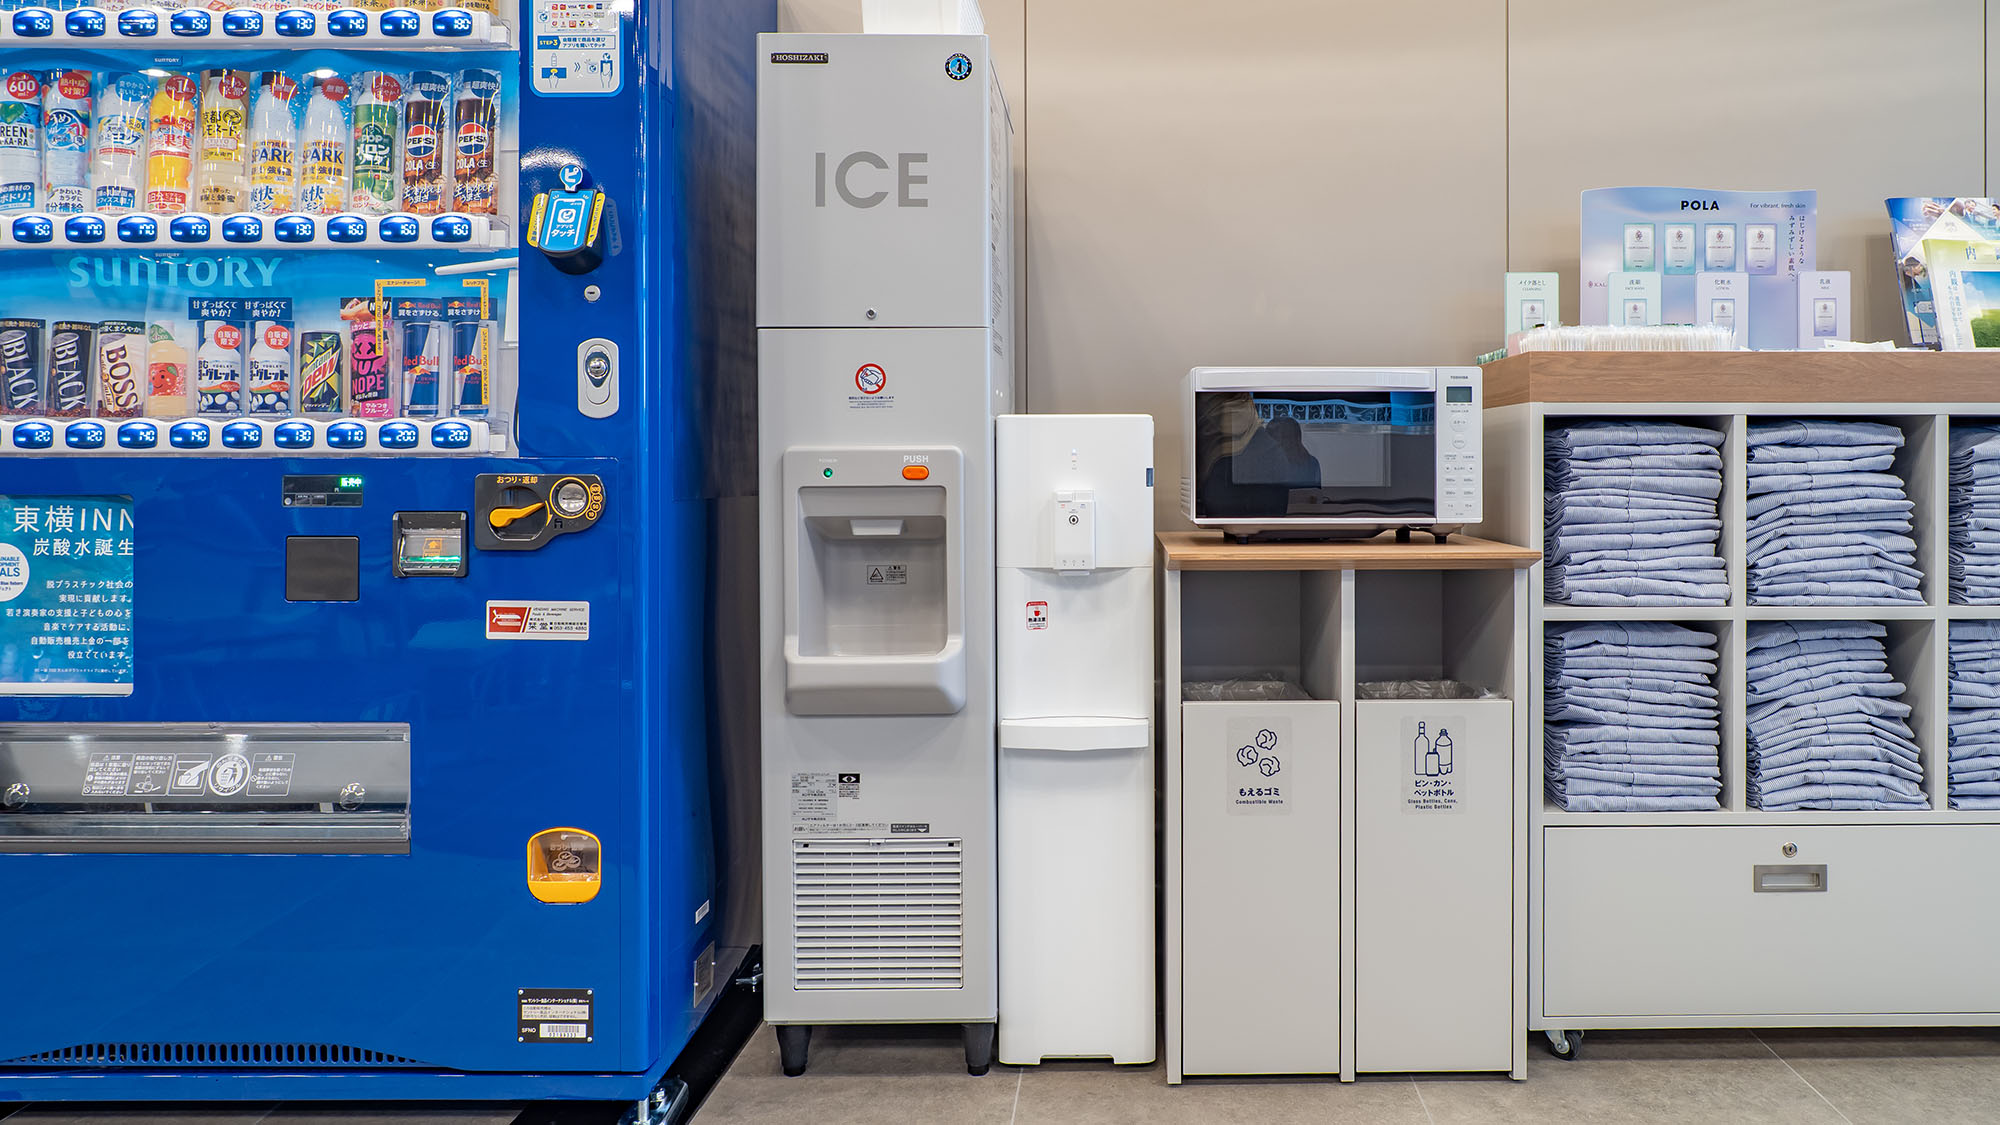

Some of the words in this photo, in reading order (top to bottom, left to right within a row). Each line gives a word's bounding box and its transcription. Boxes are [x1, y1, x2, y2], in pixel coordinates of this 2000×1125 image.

[35, 18, 50, 30] 150
[192, 18, 207, 30] 150
[244, 18, 259, 30] 130
[297, 18, 312, 30] 130
[348, 18, 364, 30] 140
[401, 18, 417, 30] 140
[454, 18, 468, 30] 180
[776, 53, 824, 62] HOSHIZAKI
[9, 81, 36, 92] 600
[0, 126, 28, 138] REEN
[362, 135, 383, 143] POP
[407, 137, 435, 145] PEPSI
[815, 151, 929, 209] ICE
[1680, 200, 1720, 211] POLA
[35, 224, 50, 235] 150
[244, 224, 259, 235] 130
[297, 224, 311, 235] 130
[348, 224, 364, 235] 160
[401, 224, 416, 235] 160
[453, 224, 468, 235] 160
[551, 228, 575, 237] タッチ
[68, 256, 283, 288] SUNTORY
[193, 300, 238, 309] 甘ずっぱくて
[245, 300, 287, 309] 甘ずっぱくて
[369, 301, 389, 312] NW
[201, 309, 231, 318] 爽やか!
[252, 309, 281, 318] 爽やか!
[398, 309, 442, 318] 翼をさずける。
[447, 308, 491, 318] 翼をさずけ。
[218, 330, 239, 339] 自販機
[267, 330, 288, 339] 自販機
[220, 338, 235, 346] 限定
[270, 338, 285, 346] 限定
[419, 355, 439, 366] Bull
[469, 355, 482, 366] Bu
[2, 340, 41, 409] BLACK
[54, 341, 86, 411] BLACK
[105, 344, 139, 408] BOSS
[352, 374, 385, 396] NOPE
[35, 430, 50, 441] 120
[87, 430, 102, 441] 120
[139, 430, 155, 441] 140
[192, 430, 207, 441] 140
[244, 430, 259, 441] 140
[296, 430, 311, 441] 130
[396, 430, 416, 441] 200
[449, 430, 468, 441] 200
[903, 455, 929, 463] PUSH
[496, 476, 539, 485] おつり・返却
[13, 505, 134, 533] 東横INN
[33, 538, 134, 556] 炭酸水誕生
[0, 567, 20, 577] ALS
[46, 580, 133, 589] 脱プラスチック社会の
[59, 594, 132, 603] 実現に貢献します。
[6, 608, 131, 617] 若き演奏家の支援と子どもの心を
[44, 623, 131, 632] 音楽でケアする活動に、
[1239, 787, 1280, 796] もえるゴミ
